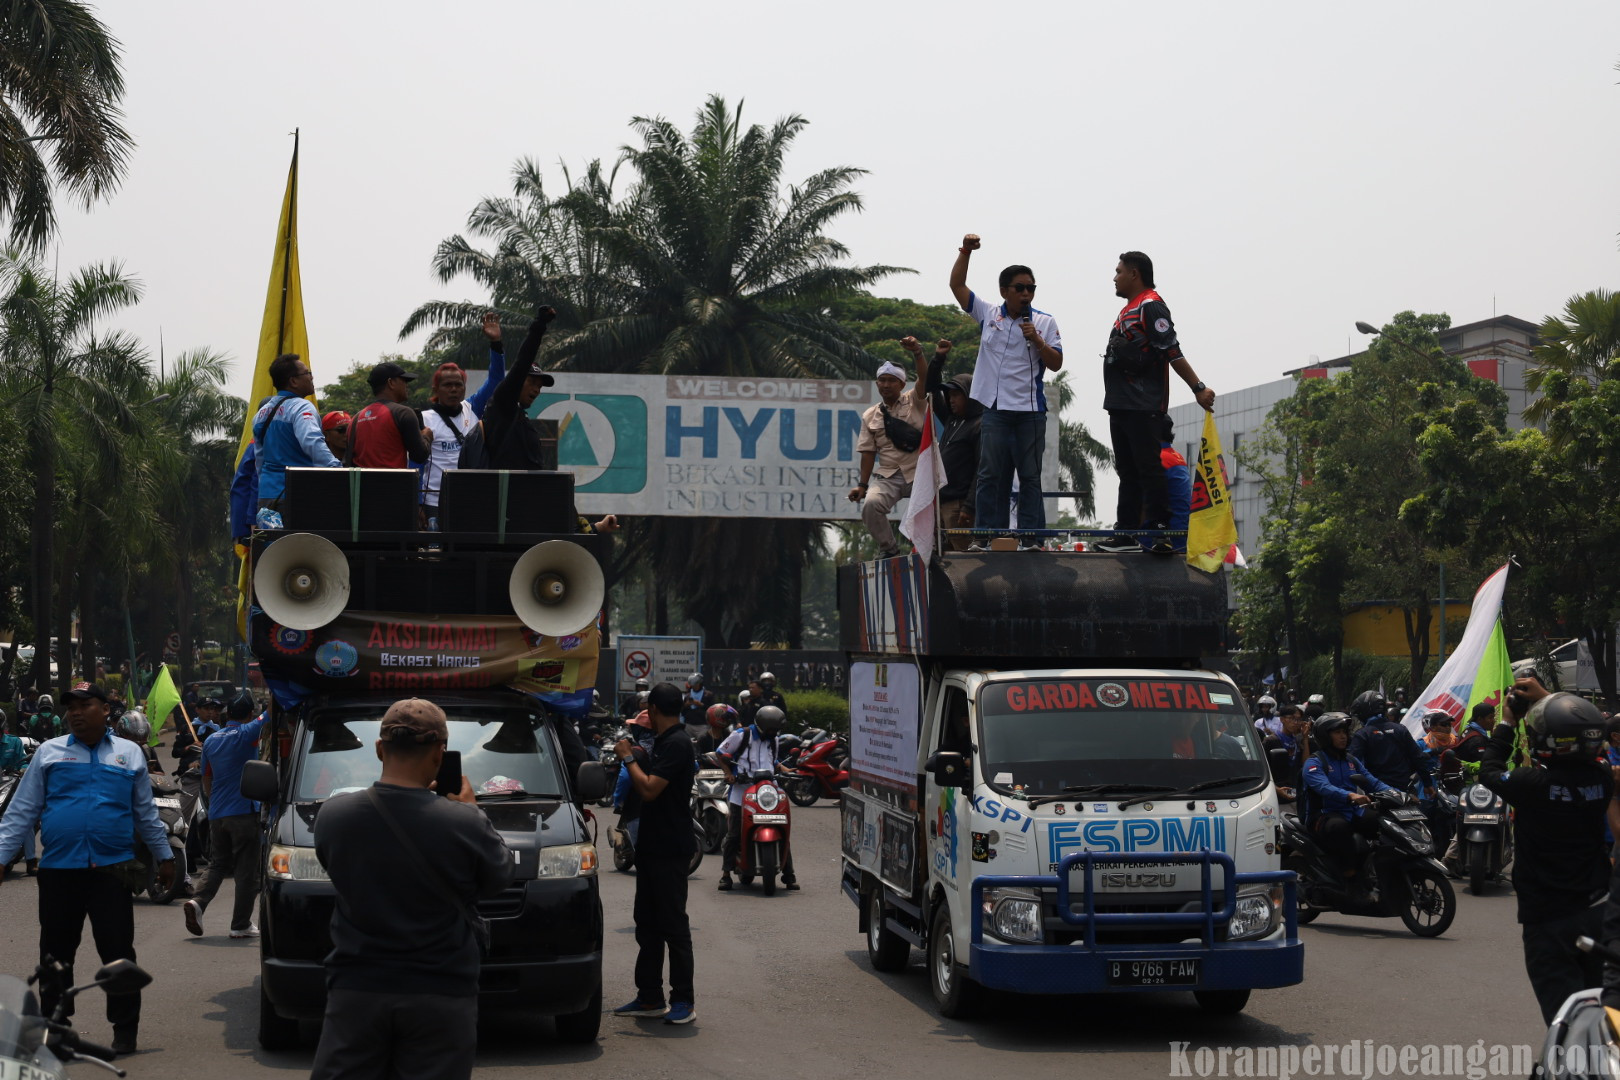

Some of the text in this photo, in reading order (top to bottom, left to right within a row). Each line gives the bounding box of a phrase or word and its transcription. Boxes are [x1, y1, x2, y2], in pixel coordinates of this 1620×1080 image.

[676, 379, 863, 399] WELCOME TO
[667, 463, 767, 487] BEKASI
[1201, 437, 1223, 505] ALIANSI
[667, 490, 850, 513] INDUSTRIAL
[367, 621, 497, 652] AKSI DAMAI
[1006, 682, 1220, 712] GARDA METAL
[1549, 784, 1605, 802] FSMI
[972, 794, 1033, 833] KSPI
[1048, 816, 1226, 863] FSPMI
[1101, 873, 1176, 888] ISUZU
[1112, 960, 1195, 978] B 9766 FAW
